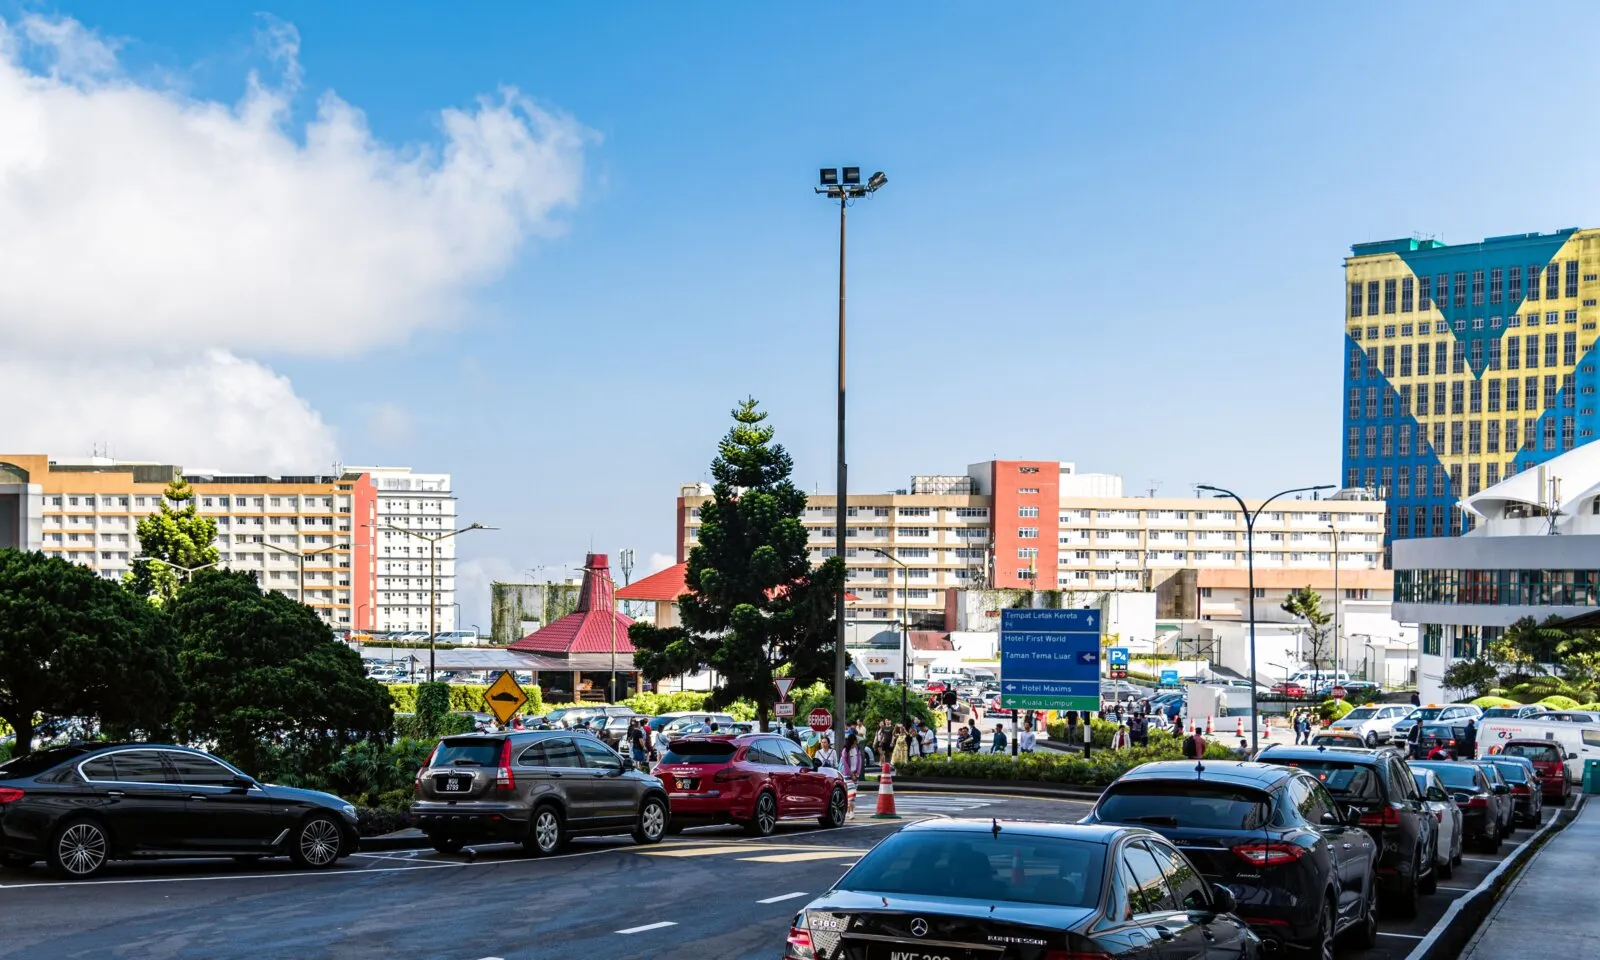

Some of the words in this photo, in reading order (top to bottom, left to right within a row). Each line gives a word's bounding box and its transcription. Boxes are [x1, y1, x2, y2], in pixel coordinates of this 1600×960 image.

[1006, 612, 1031, 620] Tempat
[1054, 652, 1071, 660] Luar
[1112, 651, 1127, 660] P4
[1045, 700, 1073, 708] Lumpur
[809, 715, 831, 726] BERHENTI
